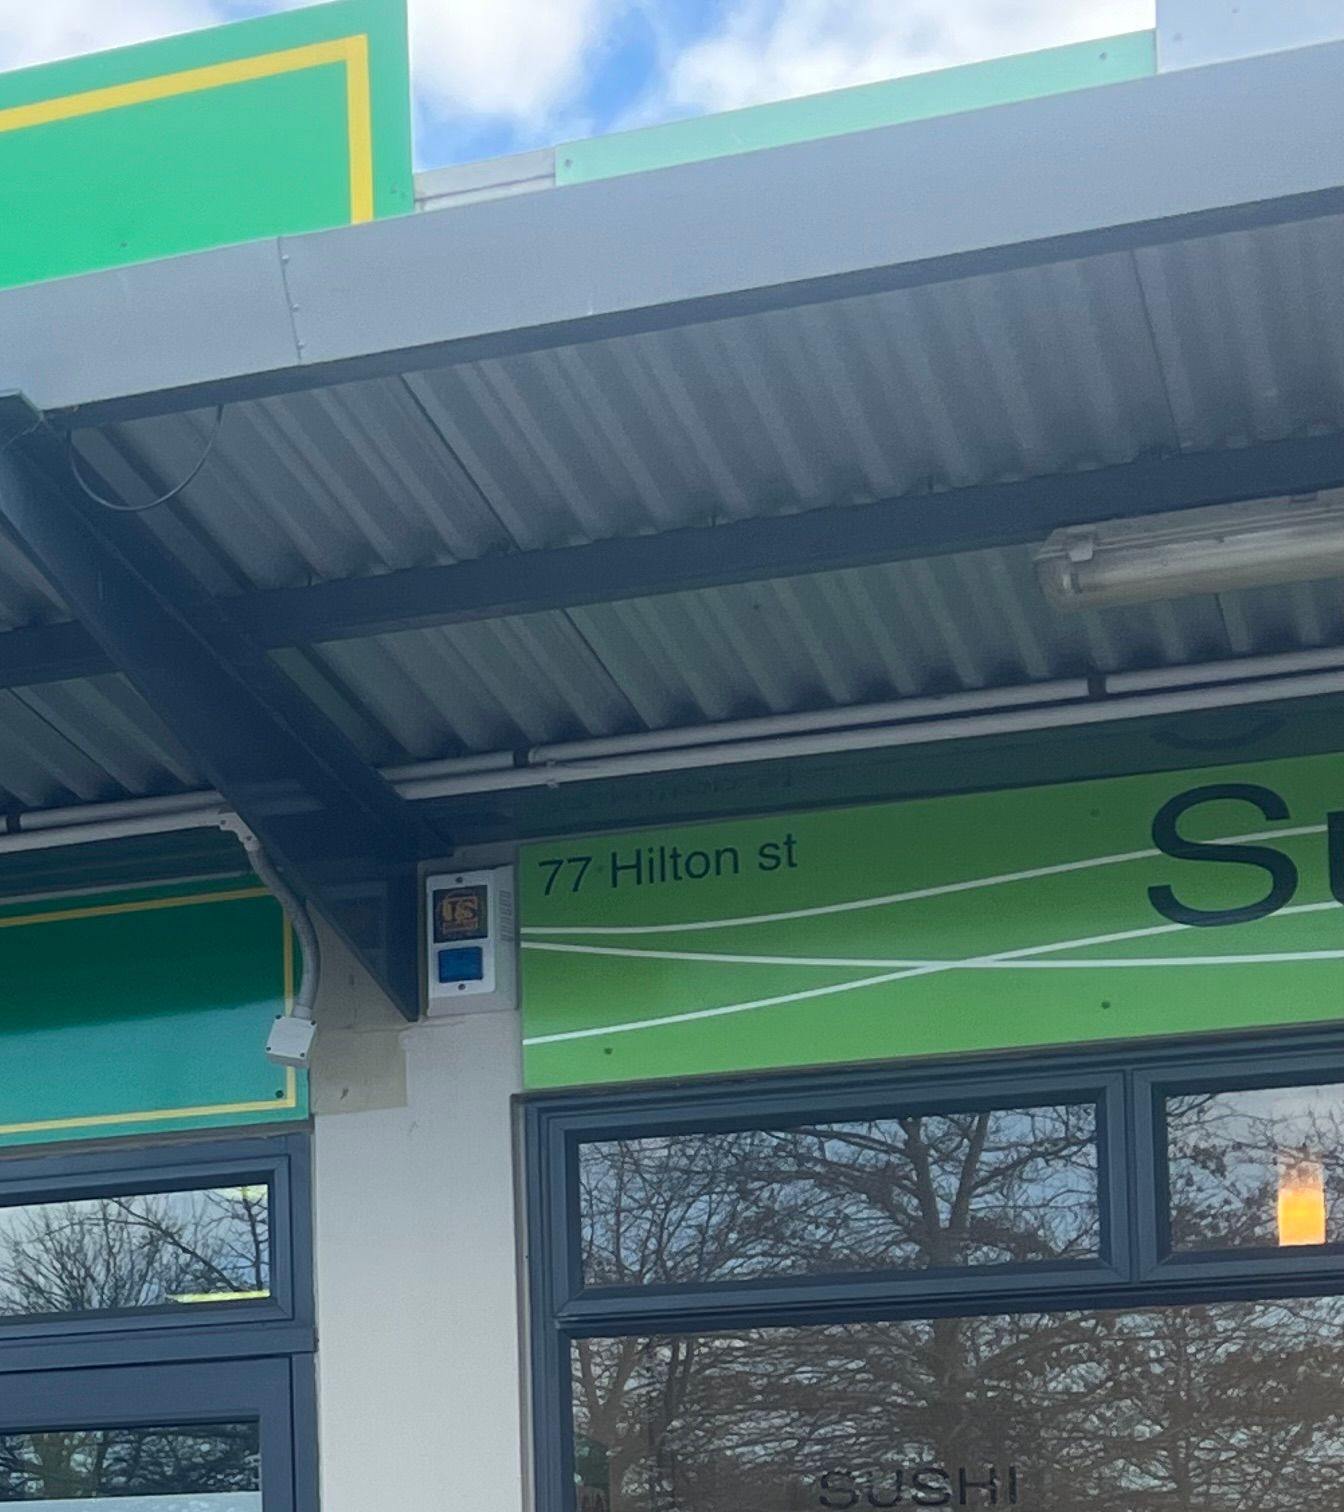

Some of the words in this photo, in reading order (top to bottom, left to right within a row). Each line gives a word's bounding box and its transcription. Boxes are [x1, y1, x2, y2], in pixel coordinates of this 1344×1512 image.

[538, 857, 593, 897] 77
[609, 840, 740, 889] Hilton
[756, 832, 799, 871] st
[1148, 782, 1344, 928] S
[818, 1464, 1022, 1511] SUSHI
